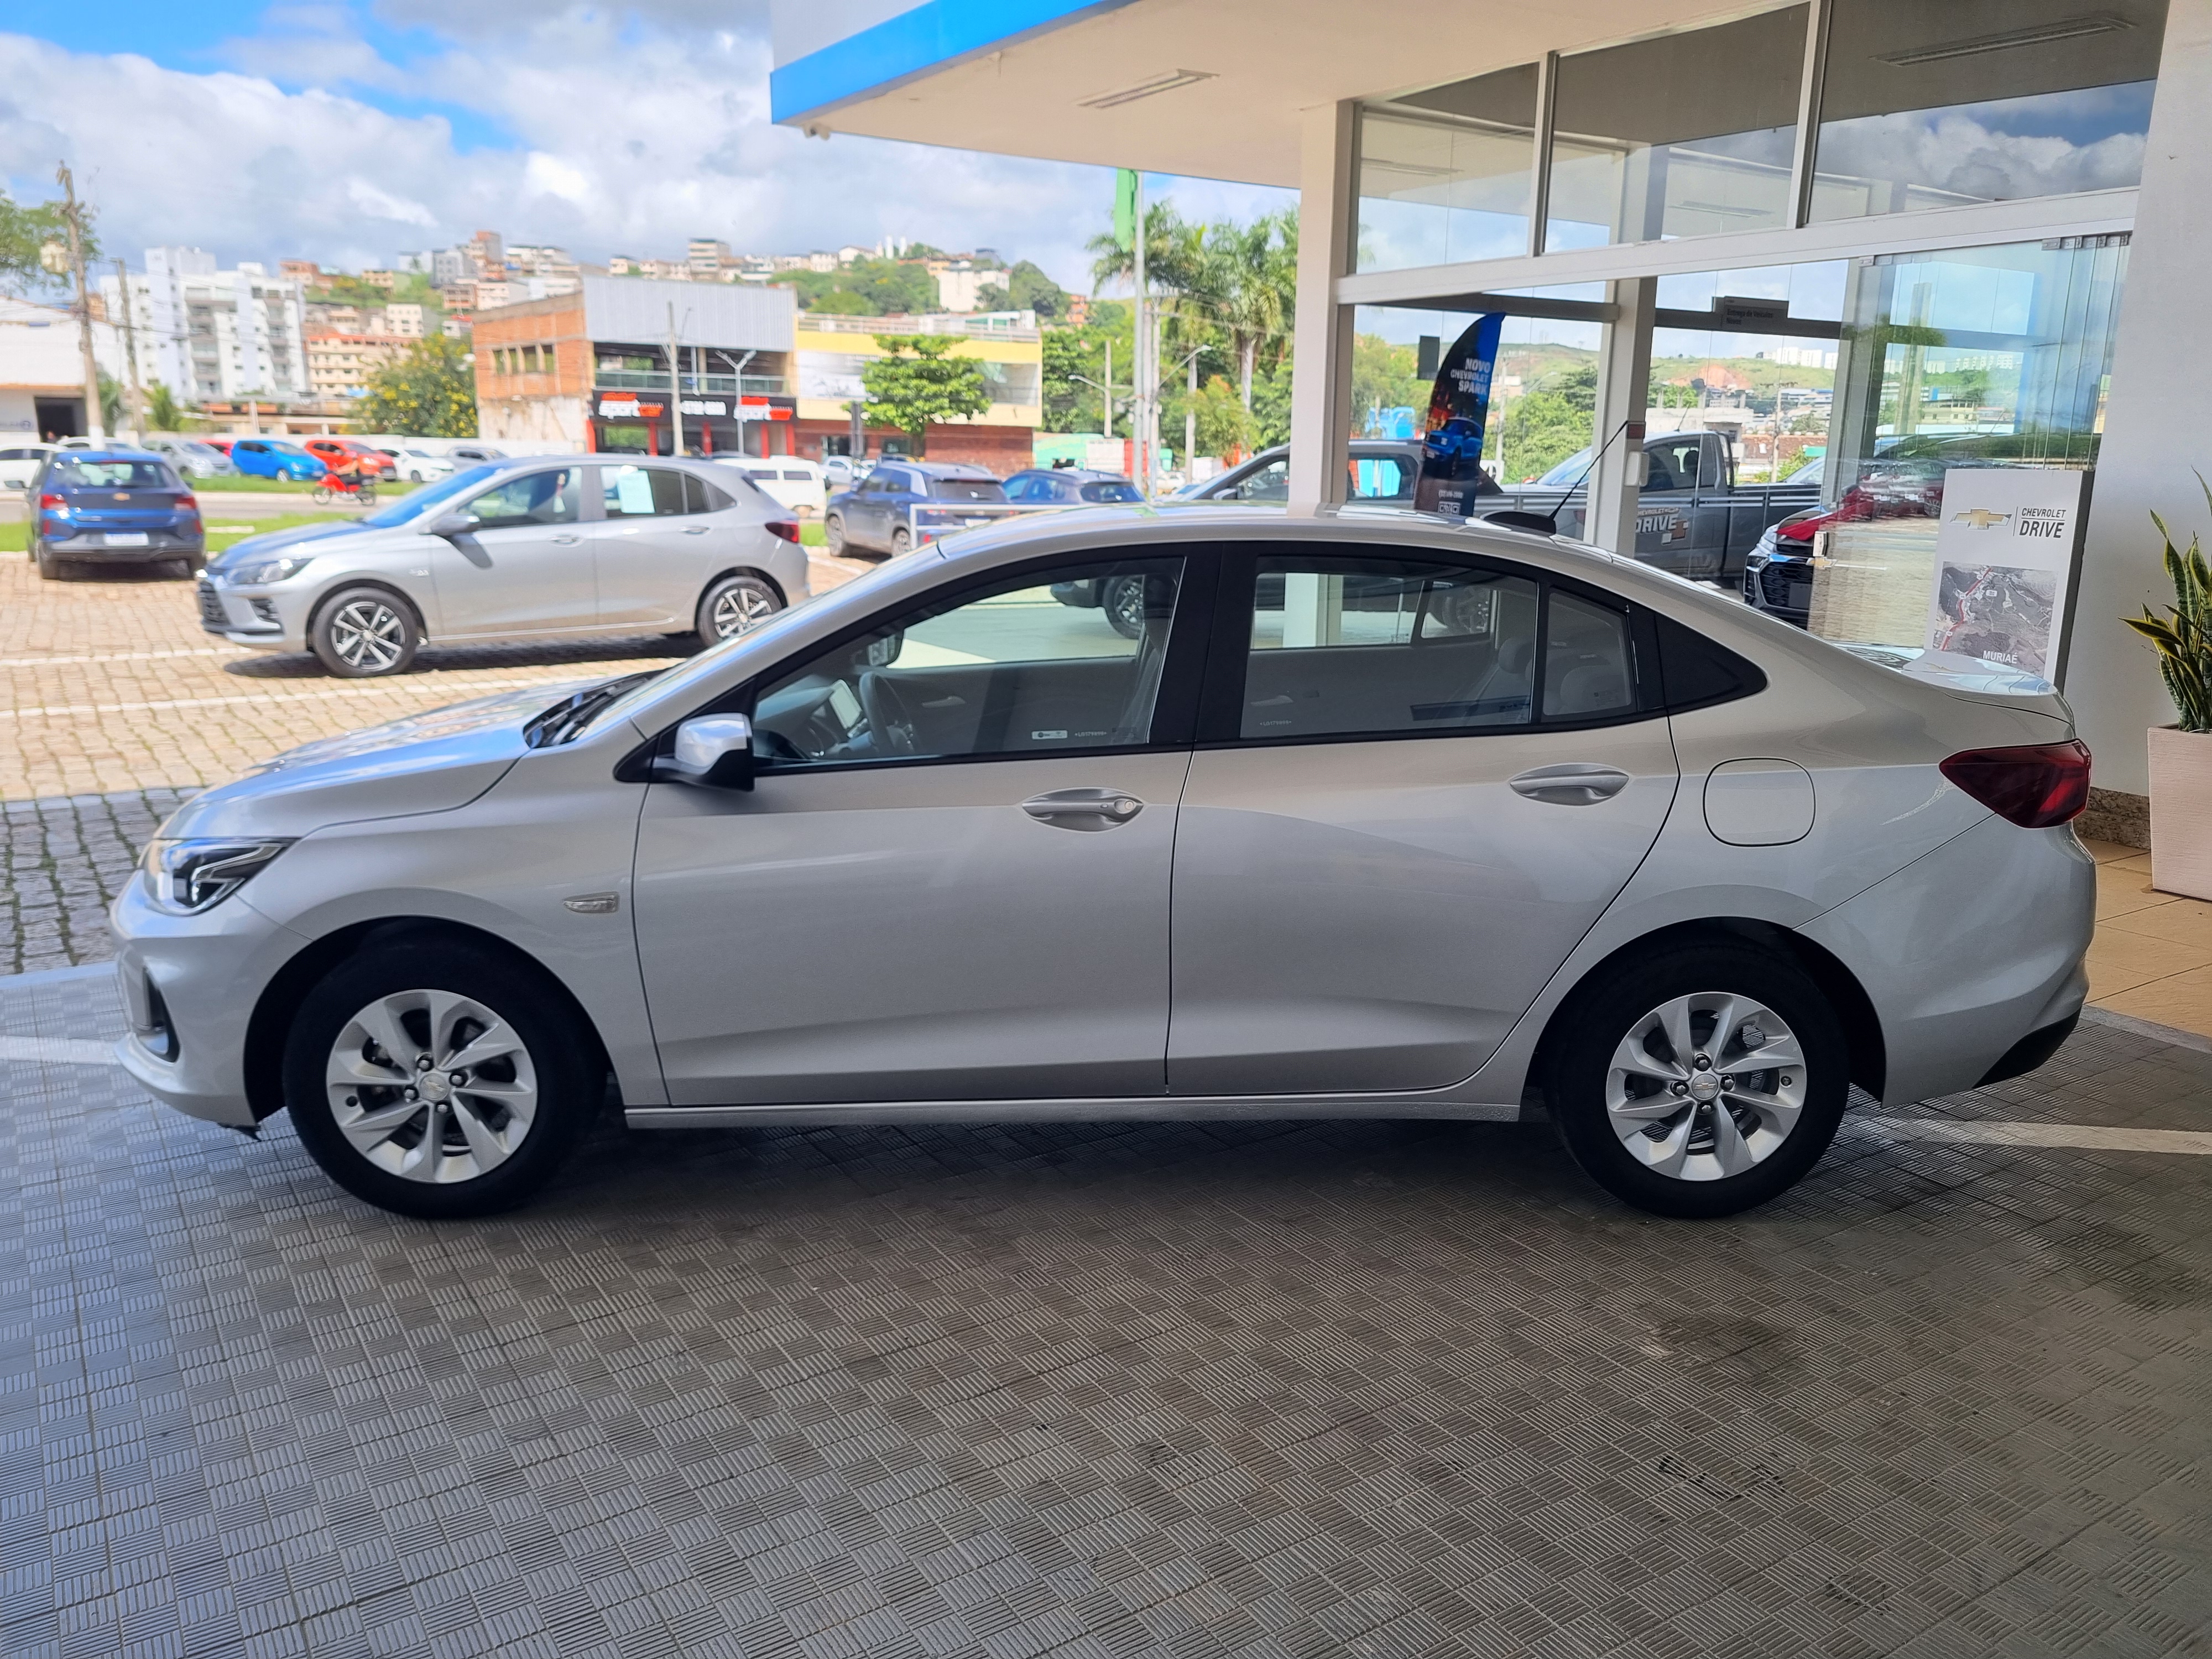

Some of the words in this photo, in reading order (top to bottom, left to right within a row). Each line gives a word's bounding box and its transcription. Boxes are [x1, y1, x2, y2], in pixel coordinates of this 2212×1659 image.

[1465, 358, 1490, 373] NOVO
[1450, 369, 1488, 382] CHEVROLET
[1458, 380, 1487, 395] SPARK
[2021, 508, 2066, 518] CHEVROLET
[2019, 520, 2065, 539] DRIVE
[1983, 649, 2018, 664] MURIAÉ
